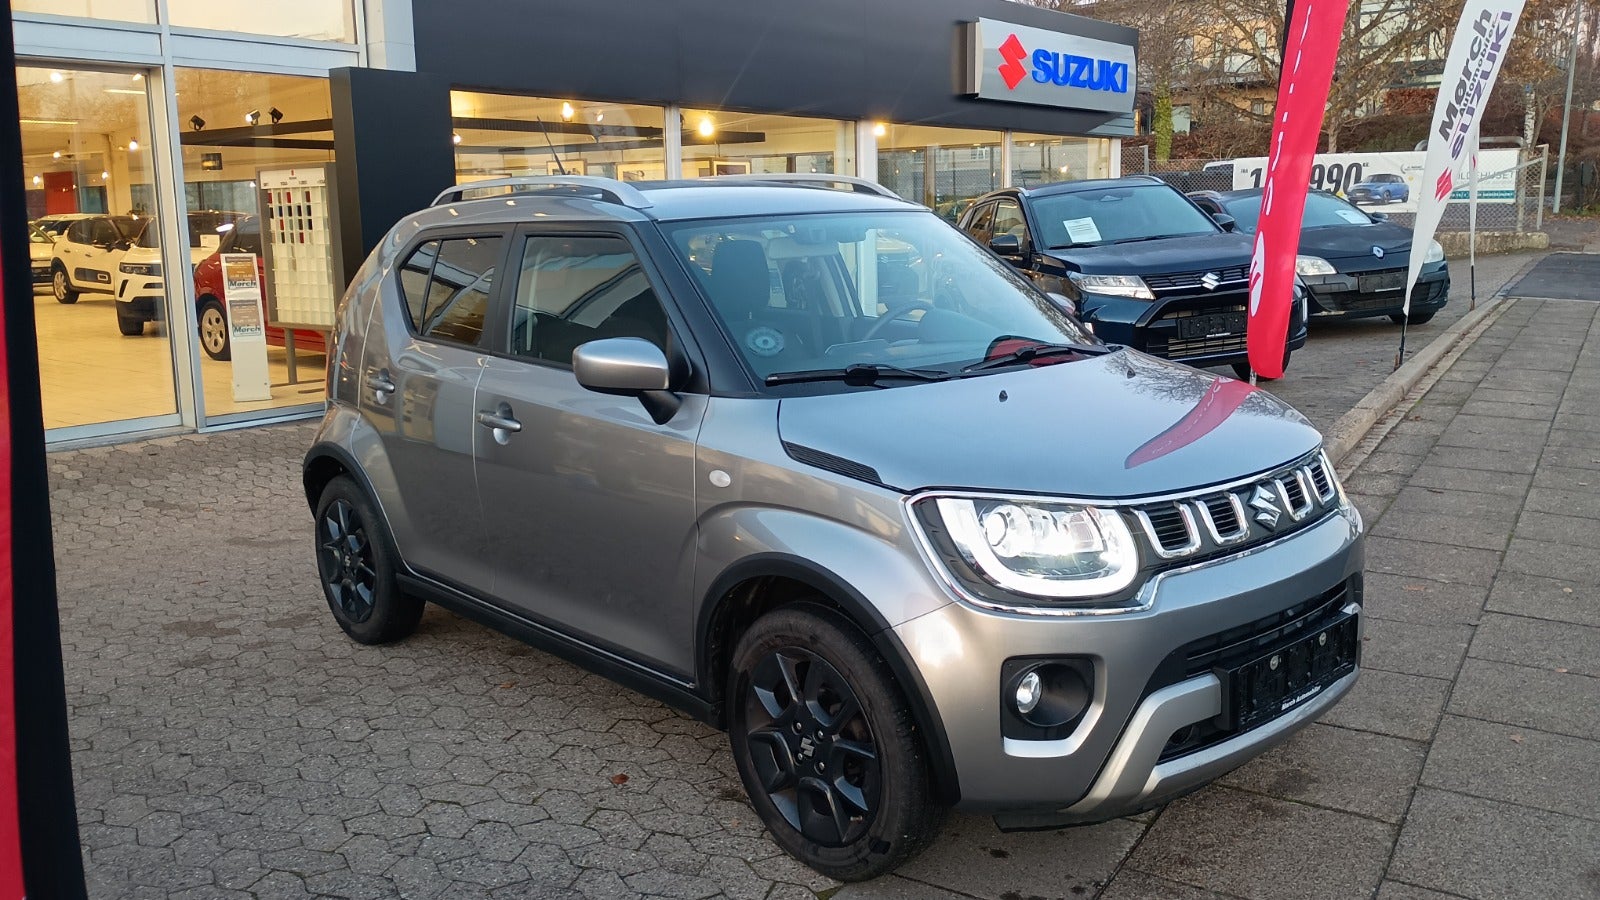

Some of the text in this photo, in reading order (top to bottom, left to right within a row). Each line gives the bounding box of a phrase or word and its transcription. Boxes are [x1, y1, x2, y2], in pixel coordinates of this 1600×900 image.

[1032, 49, 1128, 93] SUZUKI
[1438, 8, 1493, 142] Mørch
[1451, 11, 1513, 161] SUZUKI
[1458, 20, 1498, 117] Automobiler
